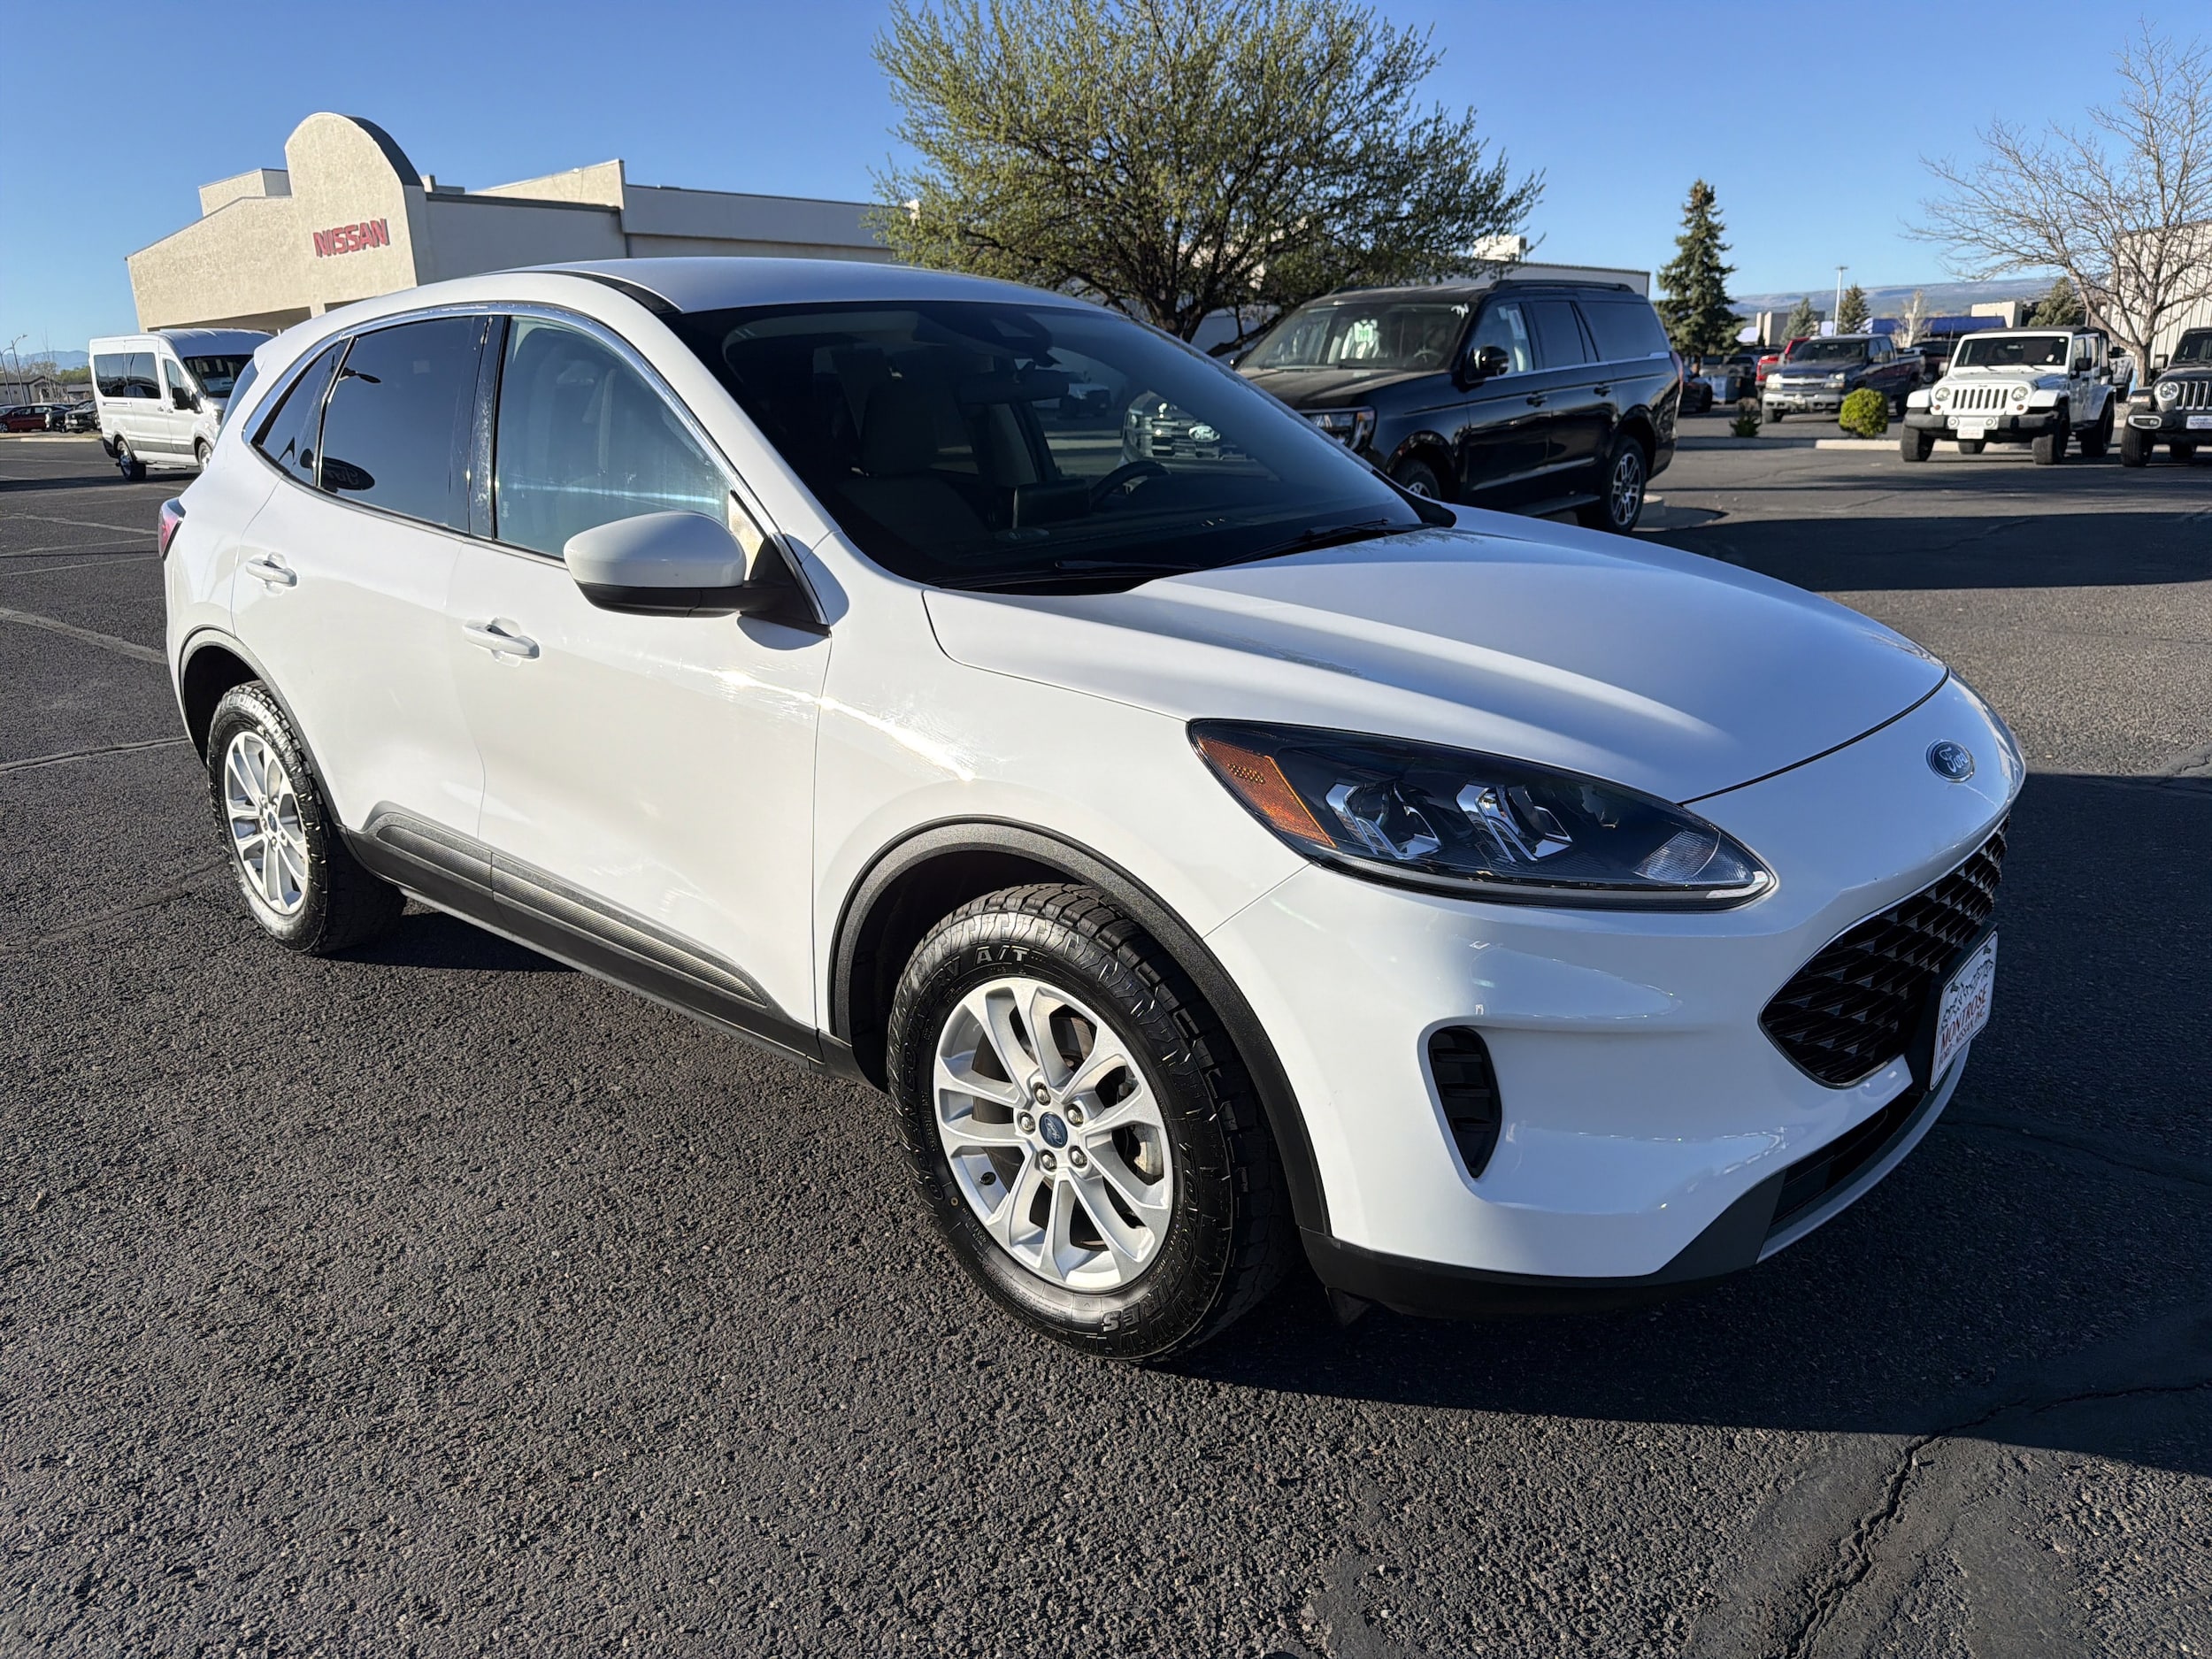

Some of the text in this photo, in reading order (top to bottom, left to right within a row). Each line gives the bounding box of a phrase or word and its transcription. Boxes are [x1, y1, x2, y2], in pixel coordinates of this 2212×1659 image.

[313, 219, 390, 257] NISSAN
[1939, 747, 1969, 772] Ford
[975, 945, 1030, 966] A/T
[1941, 982, 1988, 1052] MONTROSE
[1102, 1259, 1184, 1333] TIRES
